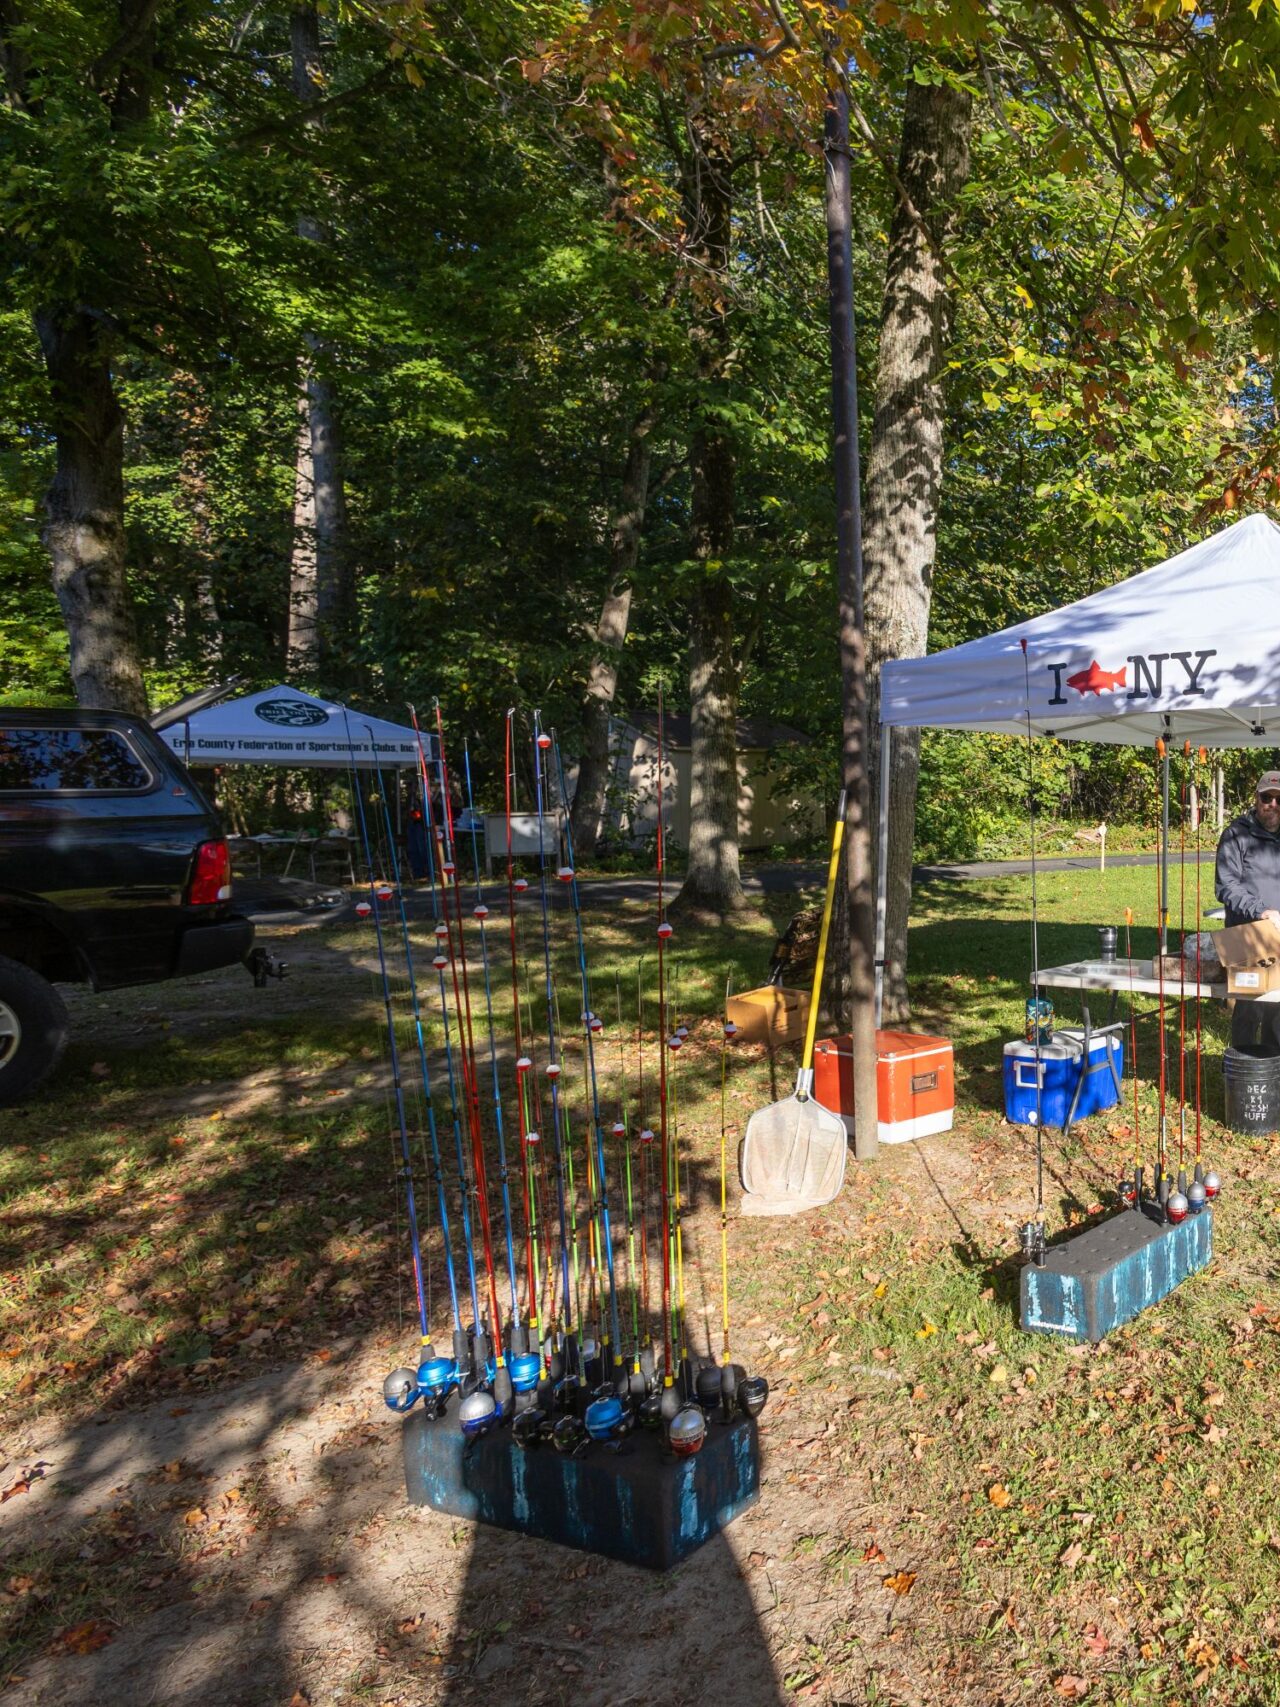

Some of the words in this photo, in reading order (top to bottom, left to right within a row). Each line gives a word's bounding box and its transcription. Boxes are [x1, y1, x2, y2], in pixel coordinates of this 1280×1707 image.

[1047, 662, 1068, 705] I
[1126, 649, 1217, 700] NY
[173, 738, 195, 748] Ere
[198, 738, 235, 751] County
[238, 739, 294, 751] Federation
[296, 741, 306, 751] of
[1245, 1104, 1269, 1113] FISH
